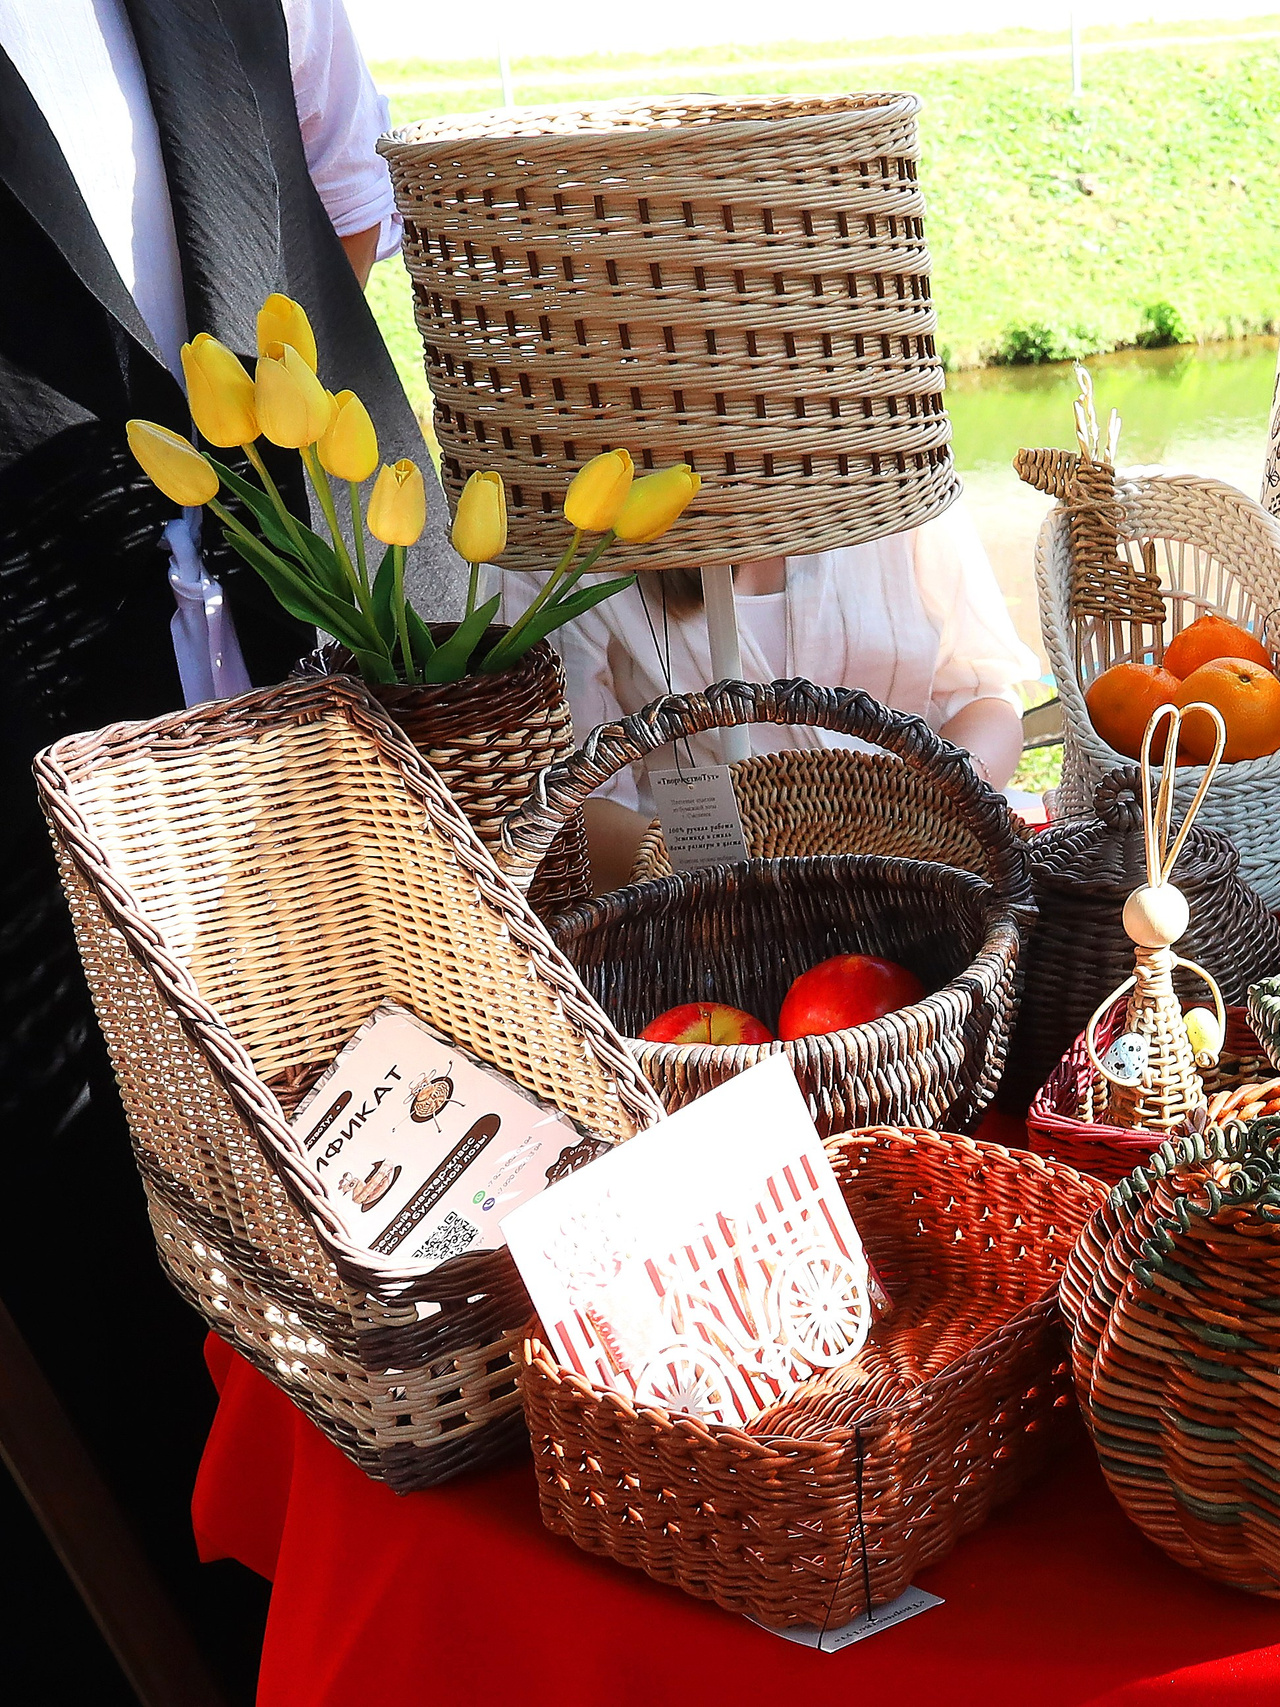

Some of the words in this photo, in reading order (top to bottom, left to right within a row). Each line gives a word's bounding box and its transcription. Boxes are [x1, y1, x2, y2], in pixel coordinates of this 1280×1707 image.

[399, 1220, 413, 1236] из
[412, 1164, 463, 1220] бумажной
[464, 1134, 488, 1163] лозы
[411, 1137, 476, 1211] мастер-класс
